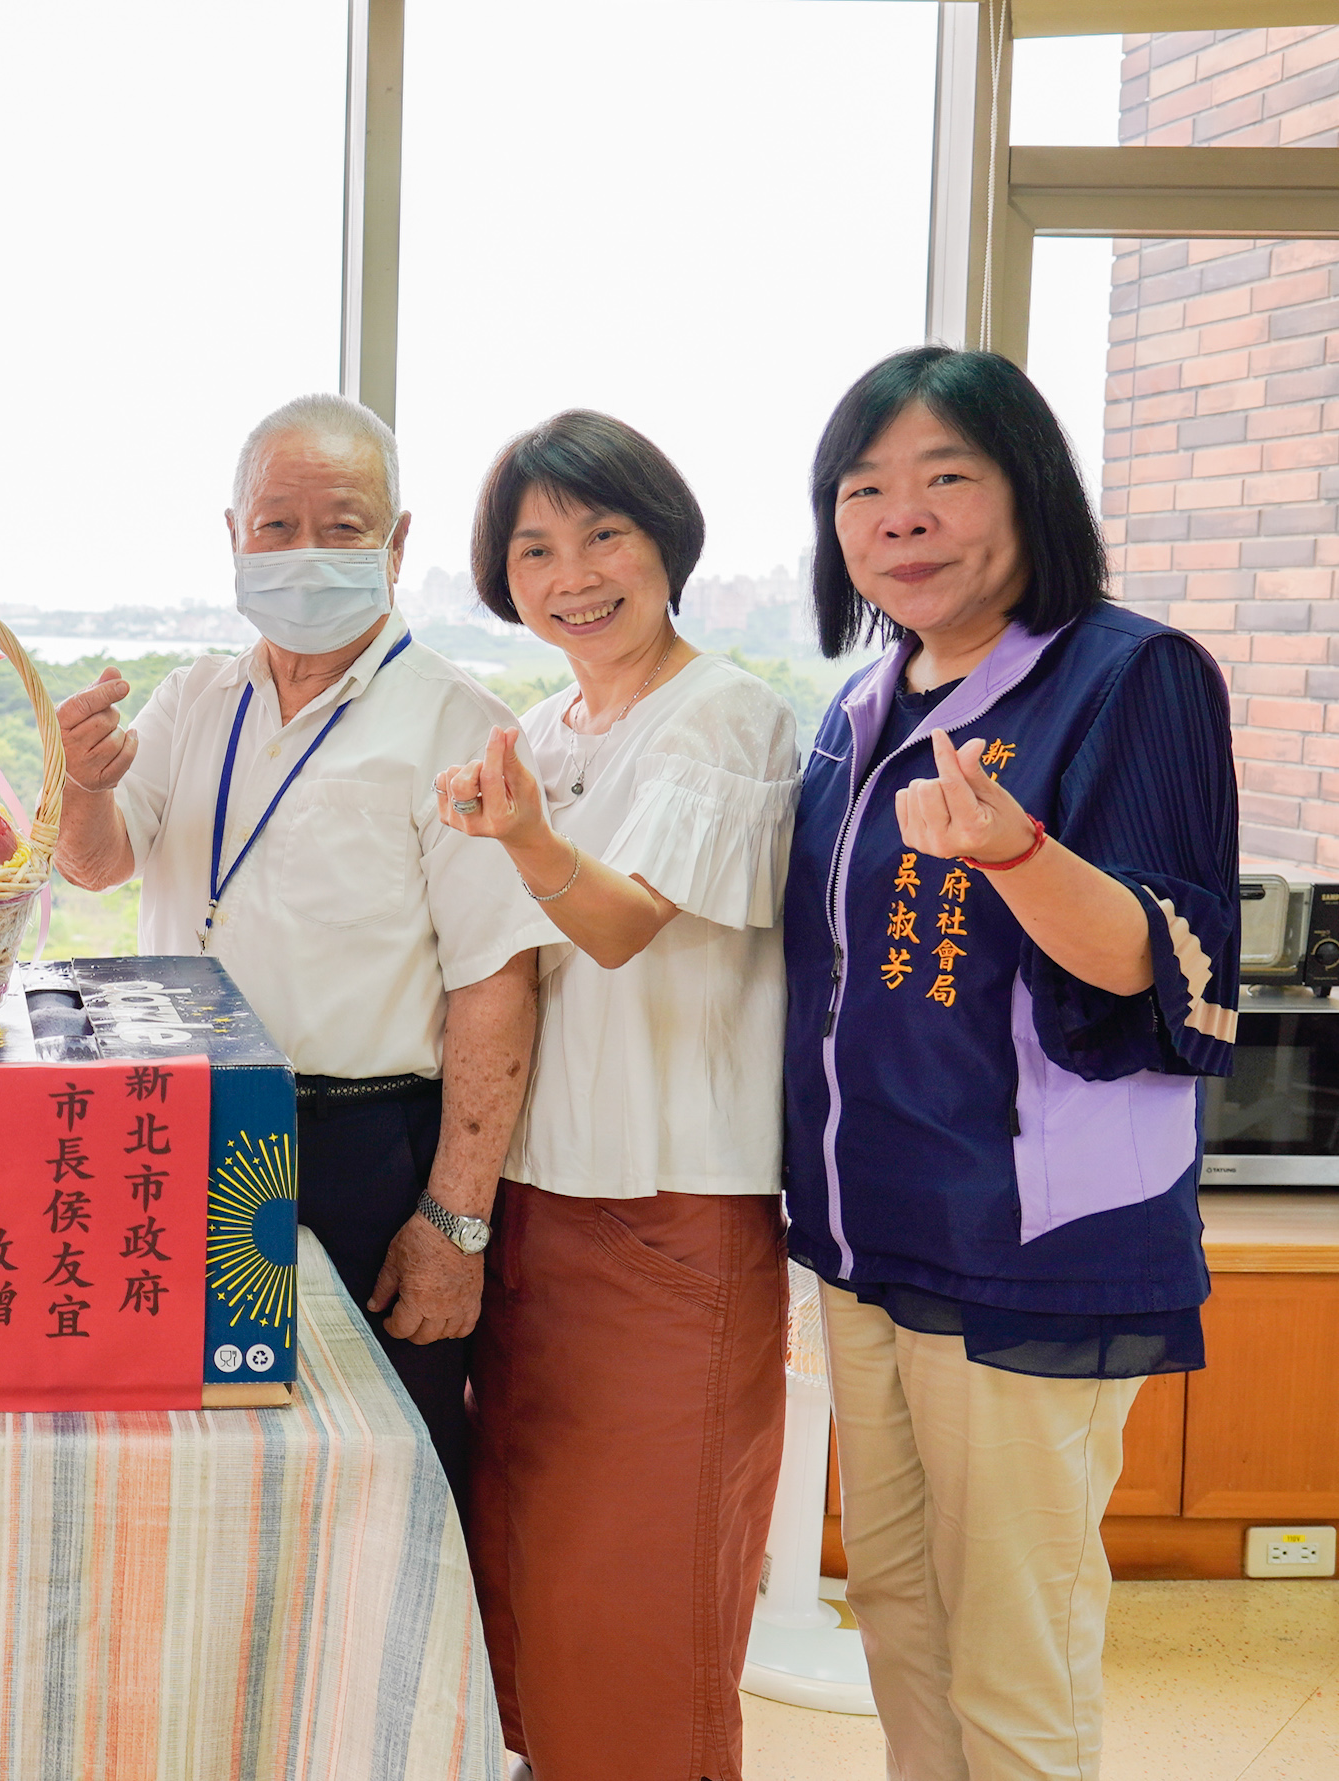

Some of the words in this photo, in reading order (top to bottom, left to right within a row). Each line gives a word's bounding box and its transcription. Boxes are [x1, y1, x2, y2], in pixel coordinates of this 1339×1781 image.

[880, 853, 921, 990] 吳淑芳
[42, 1082, 94, 1340] 市長侯友宜
[119, 1065, 174, 1316] 新北市政府
